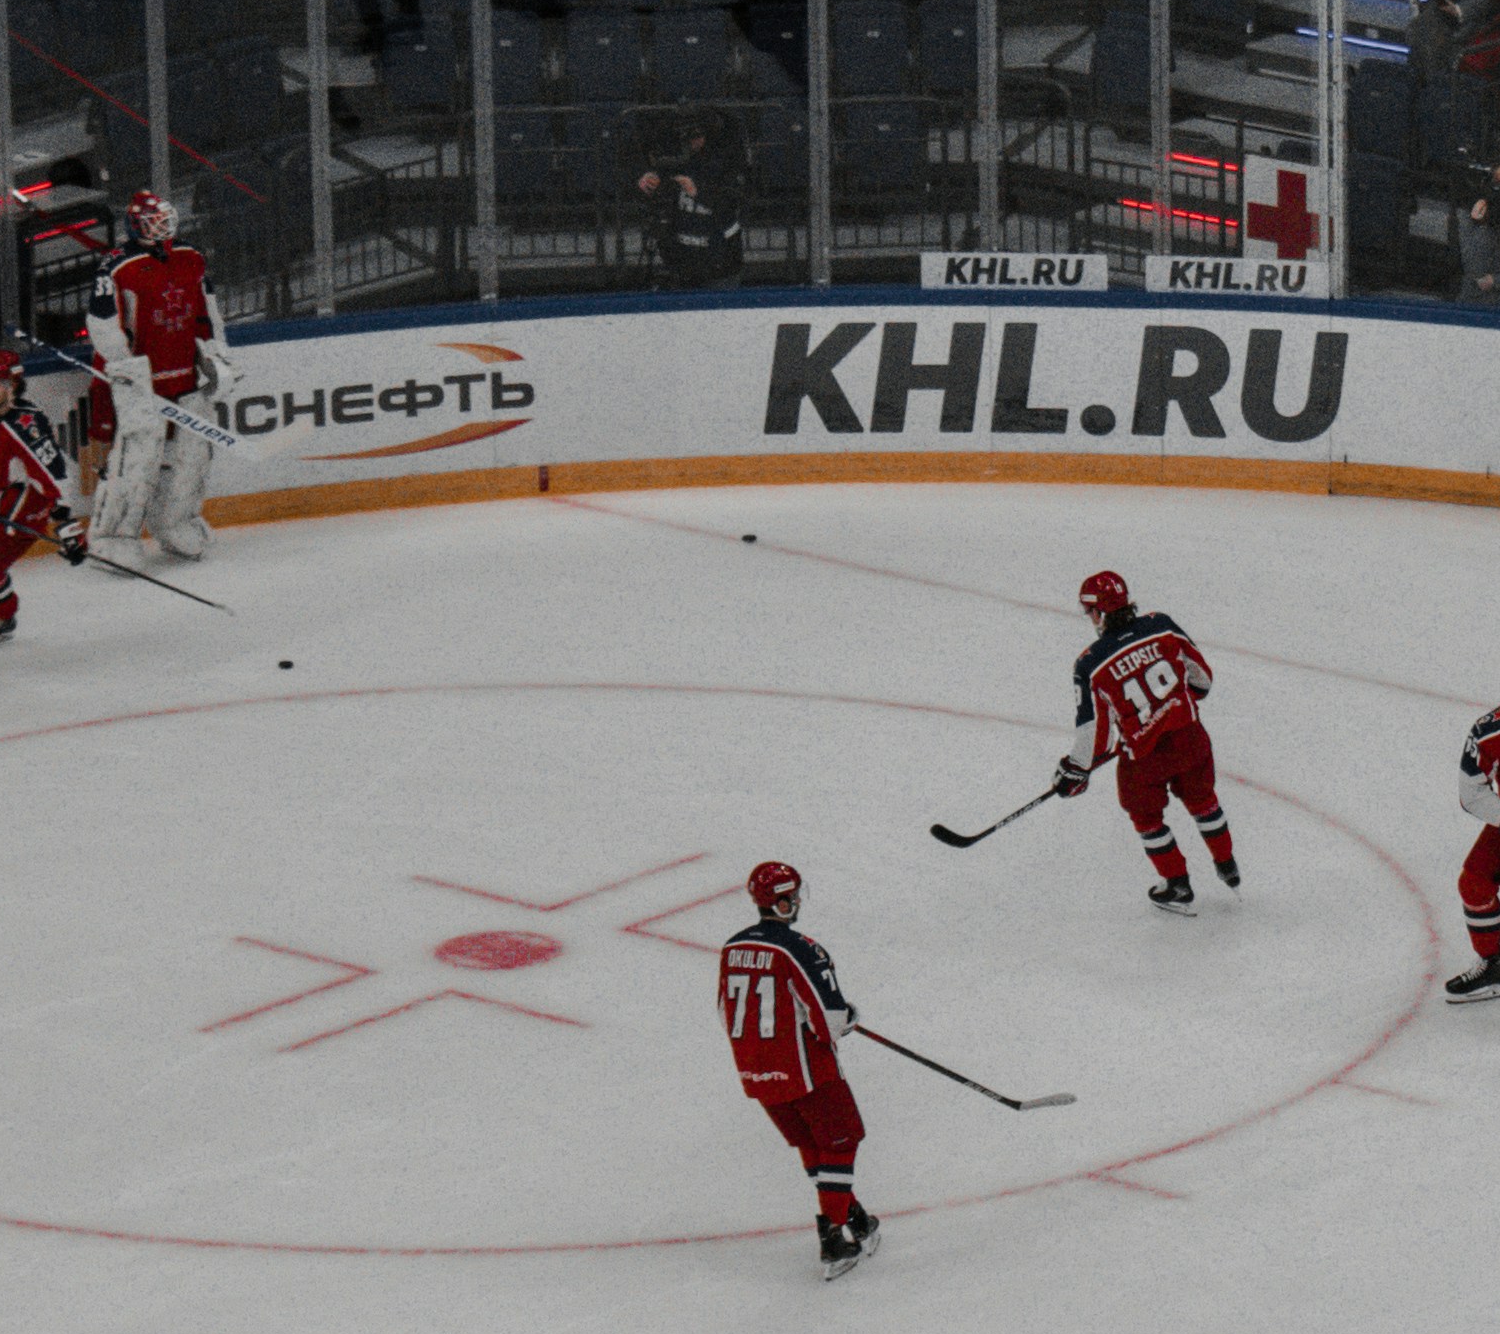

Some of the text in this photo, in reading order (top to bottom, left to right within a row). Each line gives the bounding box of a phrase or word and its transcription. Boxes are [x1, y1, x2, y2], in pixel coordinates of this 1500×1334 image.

[944, 257, 1086, 287] KHL.RU
[1168, 259, 1307, 293] KHL.RU
[214, 370, 536, 437] СНЕФТЬ
[763, 321, 1350, 444] KHL.RU
[1107, 640, 1165, 682] LEIPSIC
[727, 949, 775, 971] OKULOV
[726, 973, 777, 1041] 71
